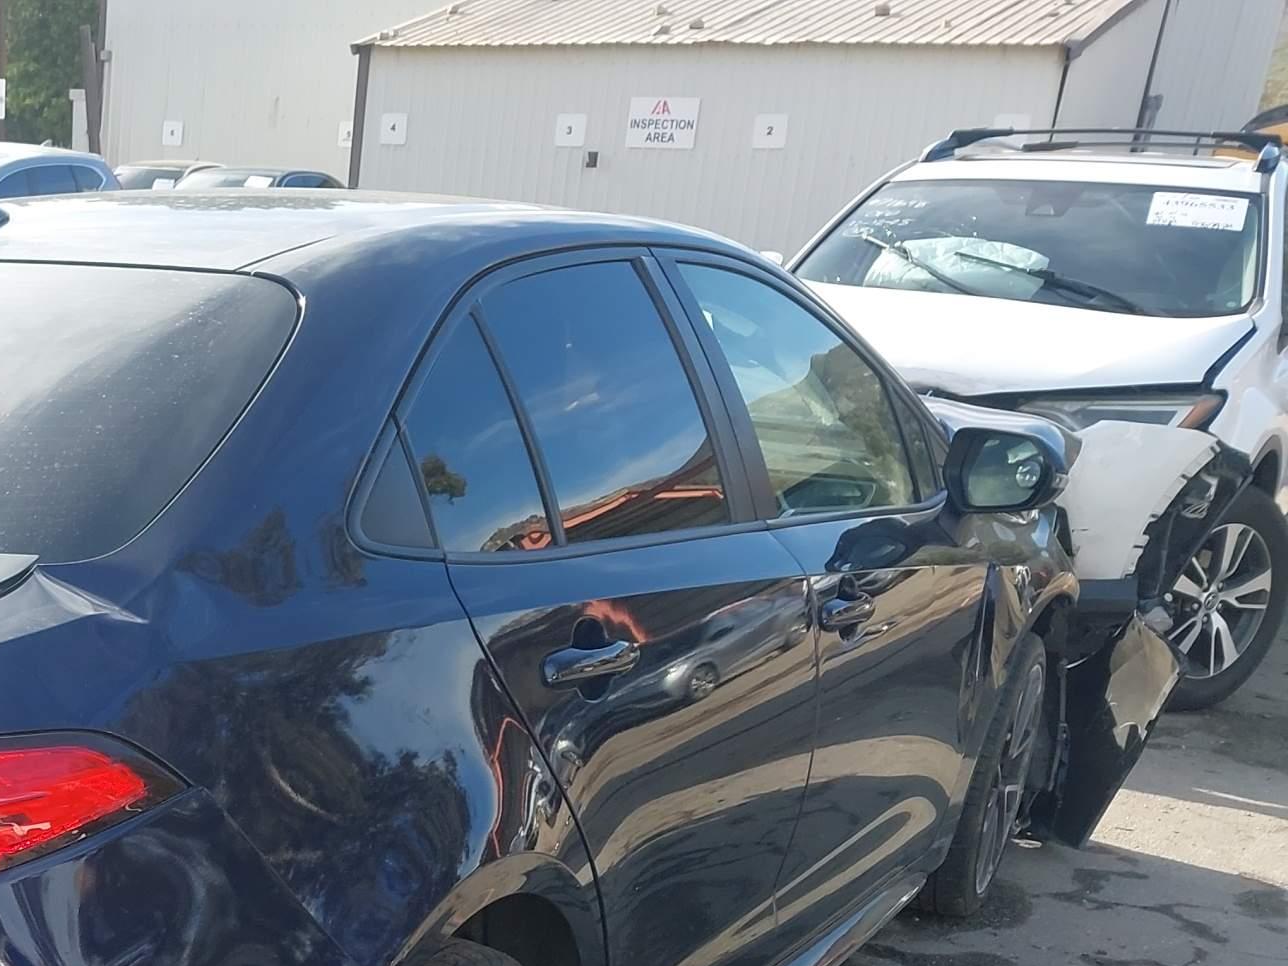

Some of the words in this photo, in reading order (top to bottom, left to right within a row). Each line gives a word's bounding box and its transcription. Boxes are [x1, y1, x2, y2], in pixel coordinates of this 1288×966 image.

[389, 123, 396, 132] 4
[630, 118, 695, 130] INSPECTION
[566, 126, 573, 135] 3
[766, 126, 774, 136] 2
[645, 131, 675, 143] AREA
